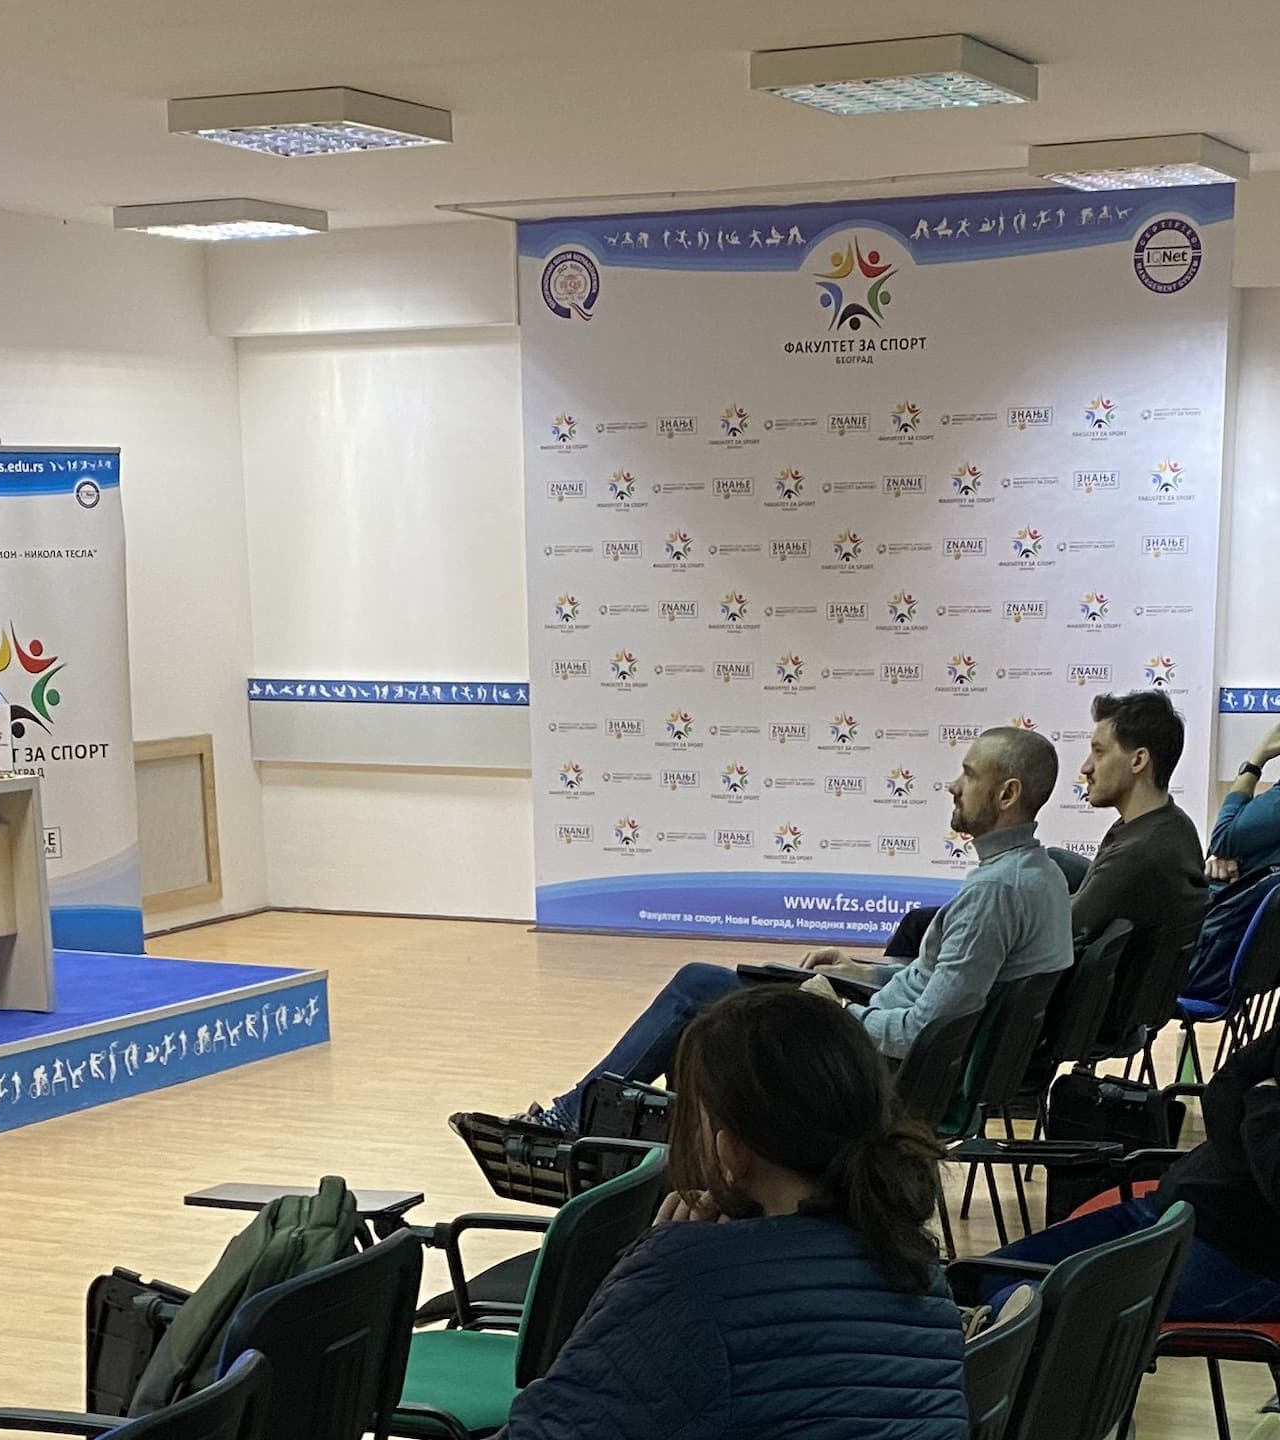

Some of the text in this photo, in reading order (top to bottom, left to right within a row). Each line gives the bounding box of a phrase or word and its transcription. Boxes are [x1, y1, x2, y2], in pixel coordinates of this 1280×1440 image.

[1146, 250, 1188, 263] IQNet
[784, 337, 927, 353] ФАКУЛТЕТ ЗА СПОРТ
[836, 355, 874, 364] БЕОГРАД
[831, 417, 866, 426] ZNANJE
[886, 478, 922, 487] ZNANJE
[947, 540, 983, 550] ZNANJE
[25, 550, 63, 559] НИКОЛА
[1007, 604, 1043, 612] ZNANJE
[717, 664, 750, 673] ZNANJE
[1071, 668, 1108, 676] ZNANJE
[772, 726, 806, 734] ZNANJE
[25, 747, 46, 763] ЗА
[51, 744, 109, 761] СПОРТ
[828, 779, 862, 787] ZNANJE
[882, 839, 916, 848] ZNANJE
[784, 894, 921, 914] www.fzs.edu.rs
[639, 910, 681, 922] Факултет
[683, 914, 693, 922] за
[695, 914, 723, 925] спорт,
[725, 916, 750, 926] Нови
[751, 917, 794, 929] Београд,
[796, 918, 845, 930] Народних
[846, 921, 878, 932] хероја
